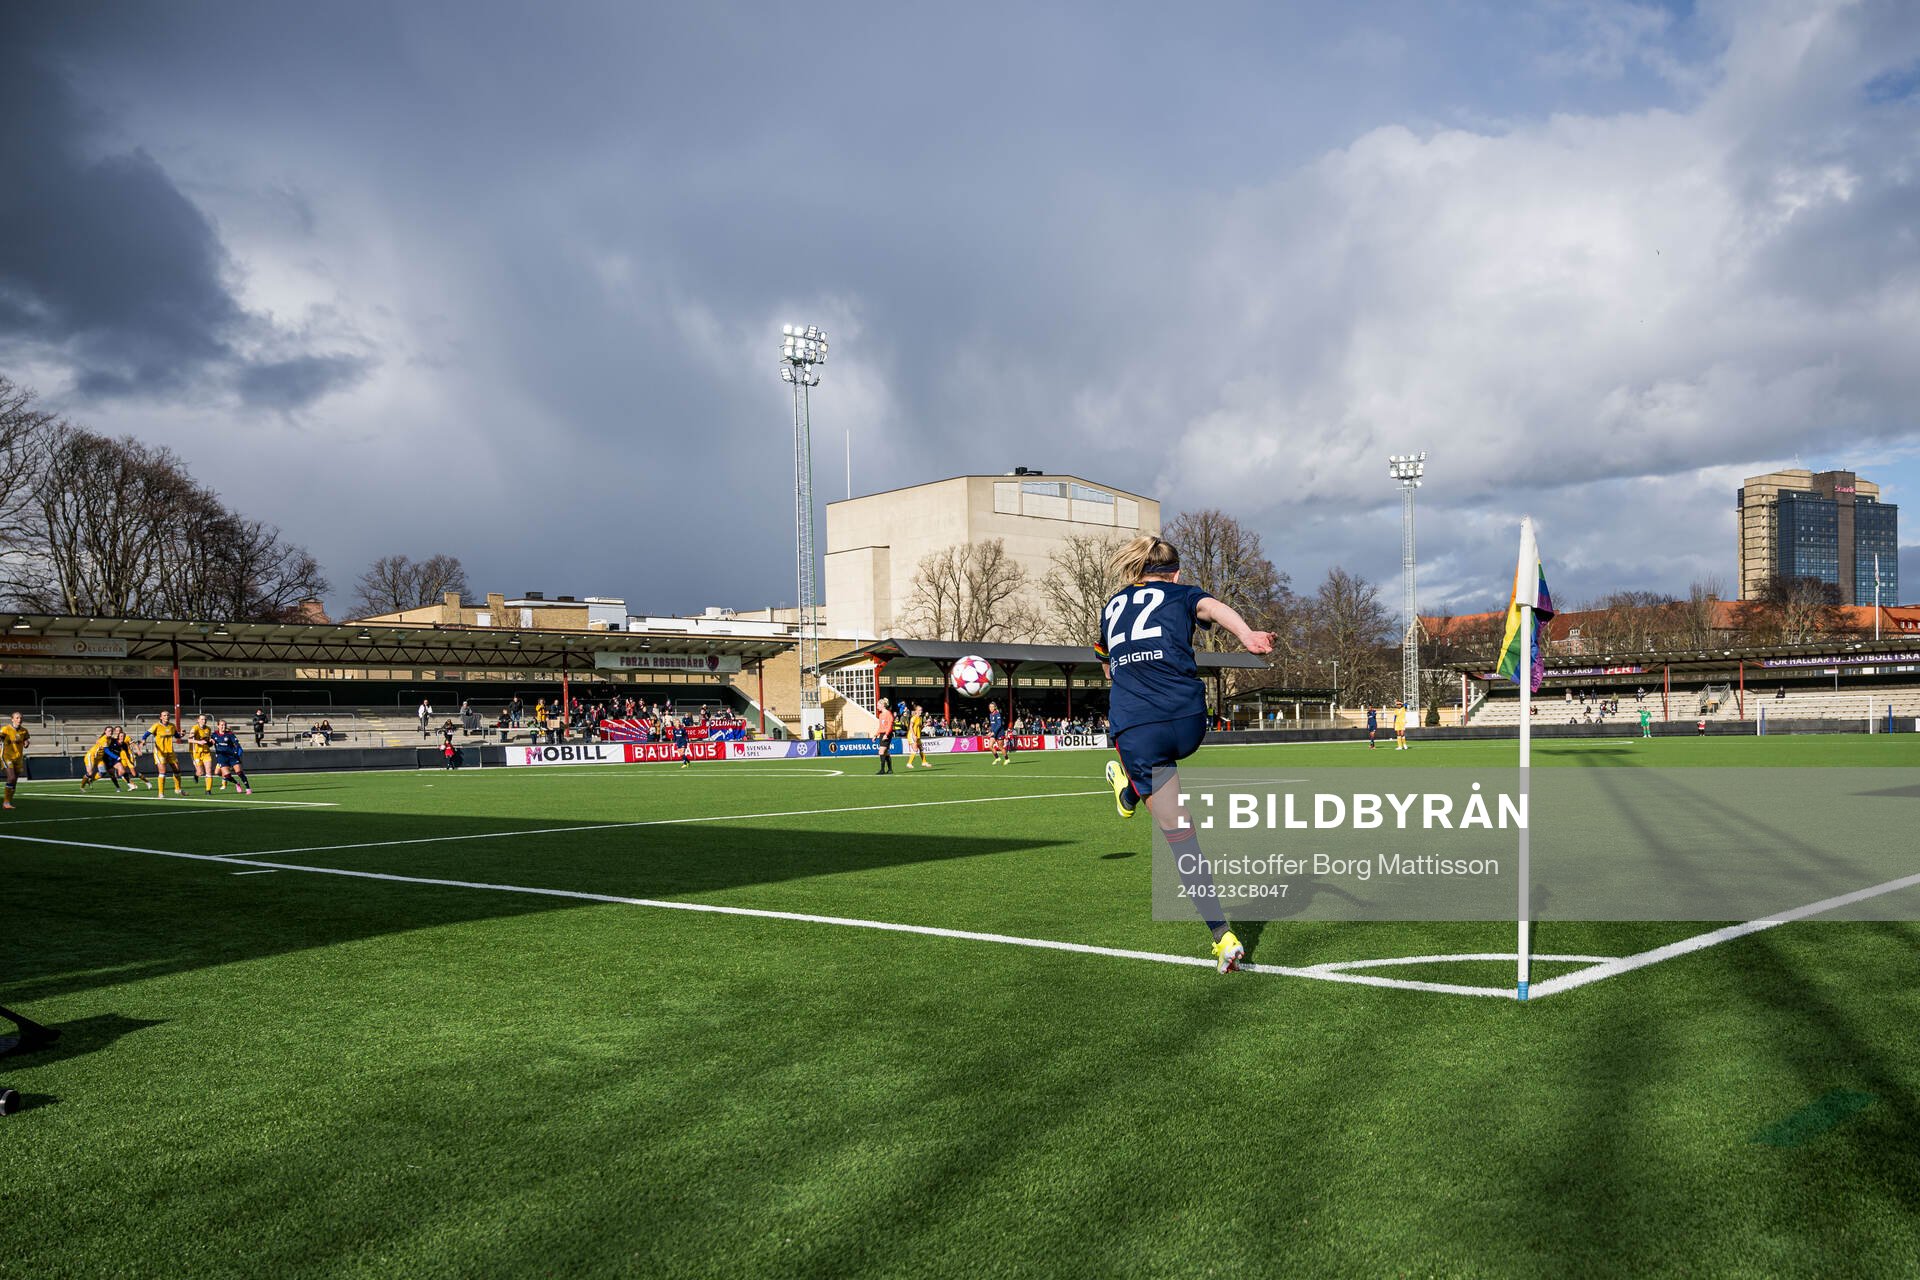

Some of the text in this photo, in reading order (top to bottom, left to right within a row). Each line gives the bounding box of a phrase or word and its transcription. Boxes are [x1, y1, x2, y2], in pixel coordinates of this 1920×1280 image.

[1105, 588, 1165, 652] 22
[620, 655, 704, 668] FORZA ROSENGÅRD
[840, 743, 871, 751] SVENSKA
[1055, 735, 1098, 749] MOBILL
[525, 746, 607, 764] MOBILL
